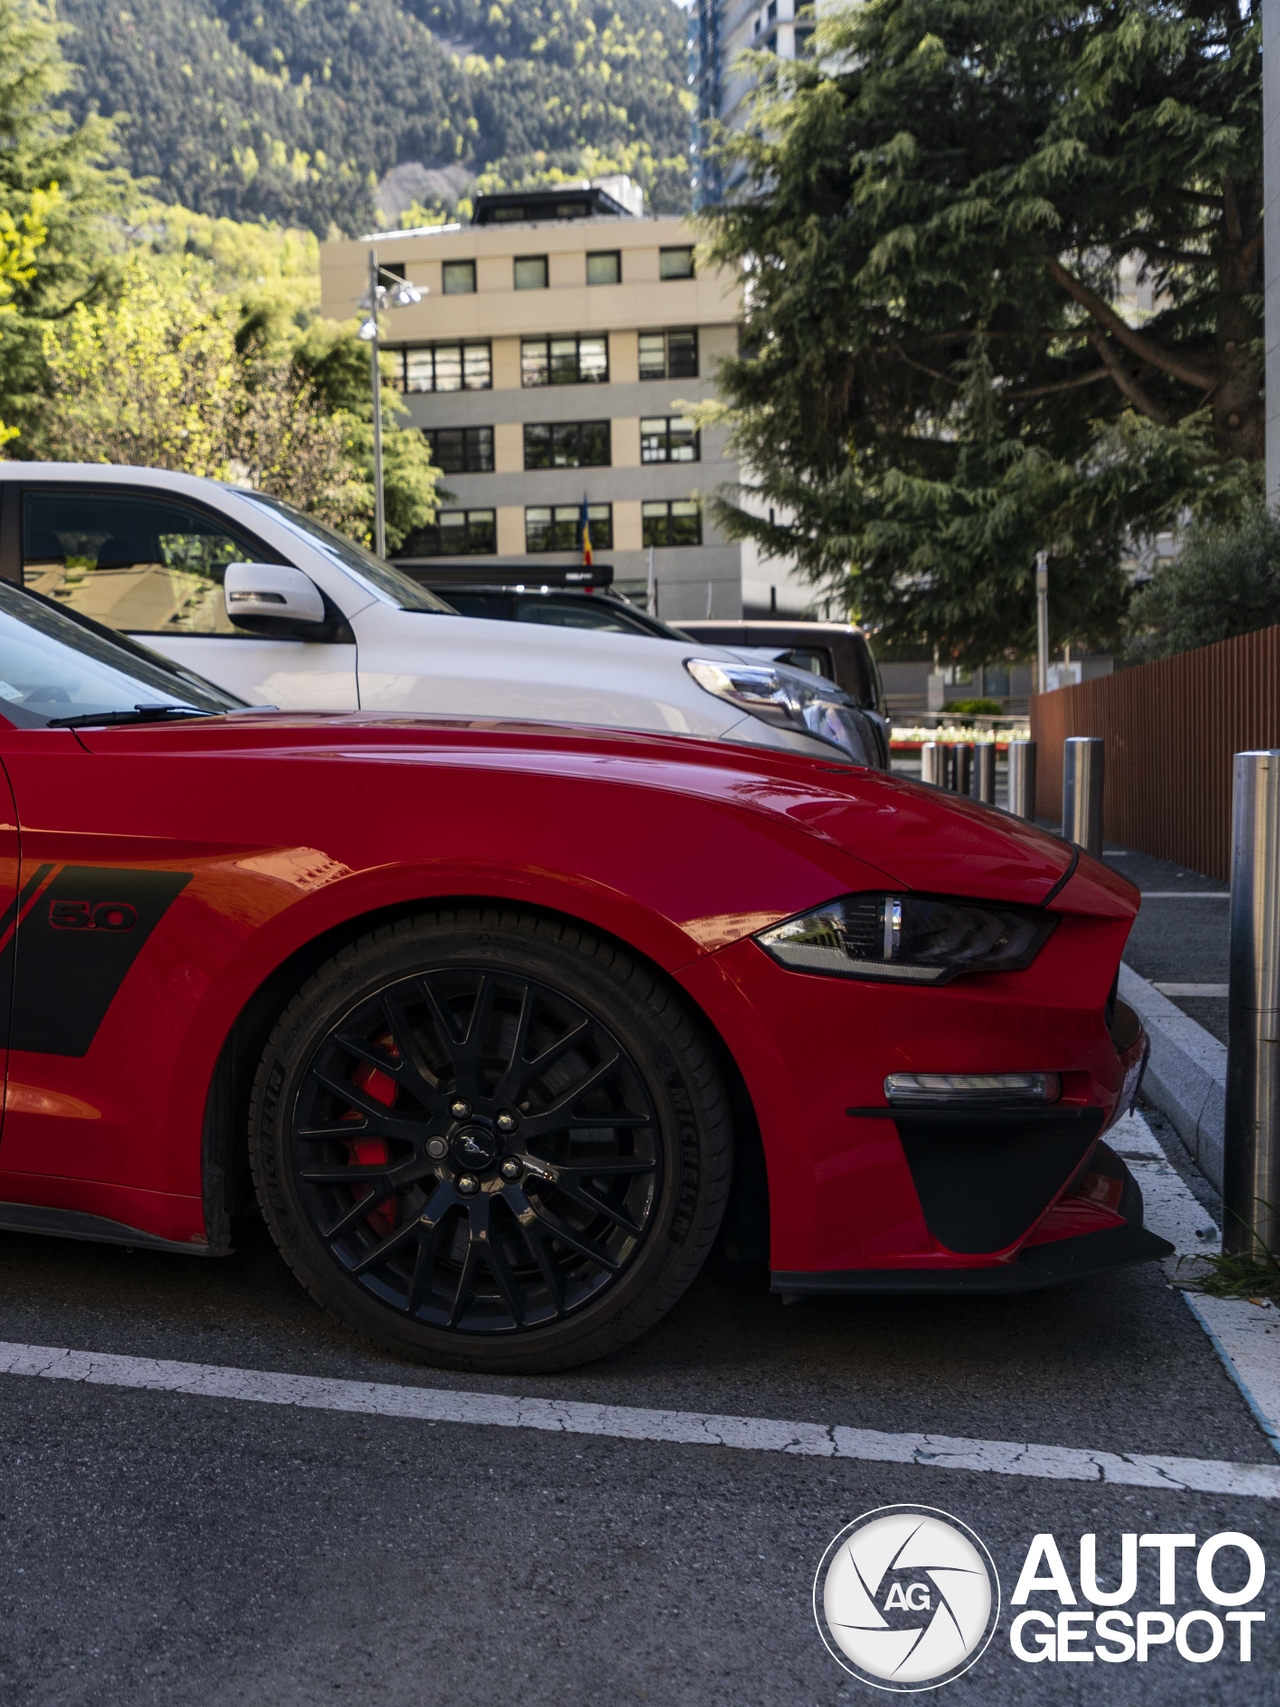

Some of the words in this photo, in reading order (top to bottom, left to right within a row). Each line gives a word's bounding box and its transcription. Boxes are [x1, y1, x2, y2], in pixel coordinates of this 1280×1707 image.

[282, 1019, 303, 1053] PILOT
[303, 986, 331, 1021] SPORT
[262, 1068, 285, 1209] MICHELIN
[671, 1087, 698, 1237] MICHELIN
